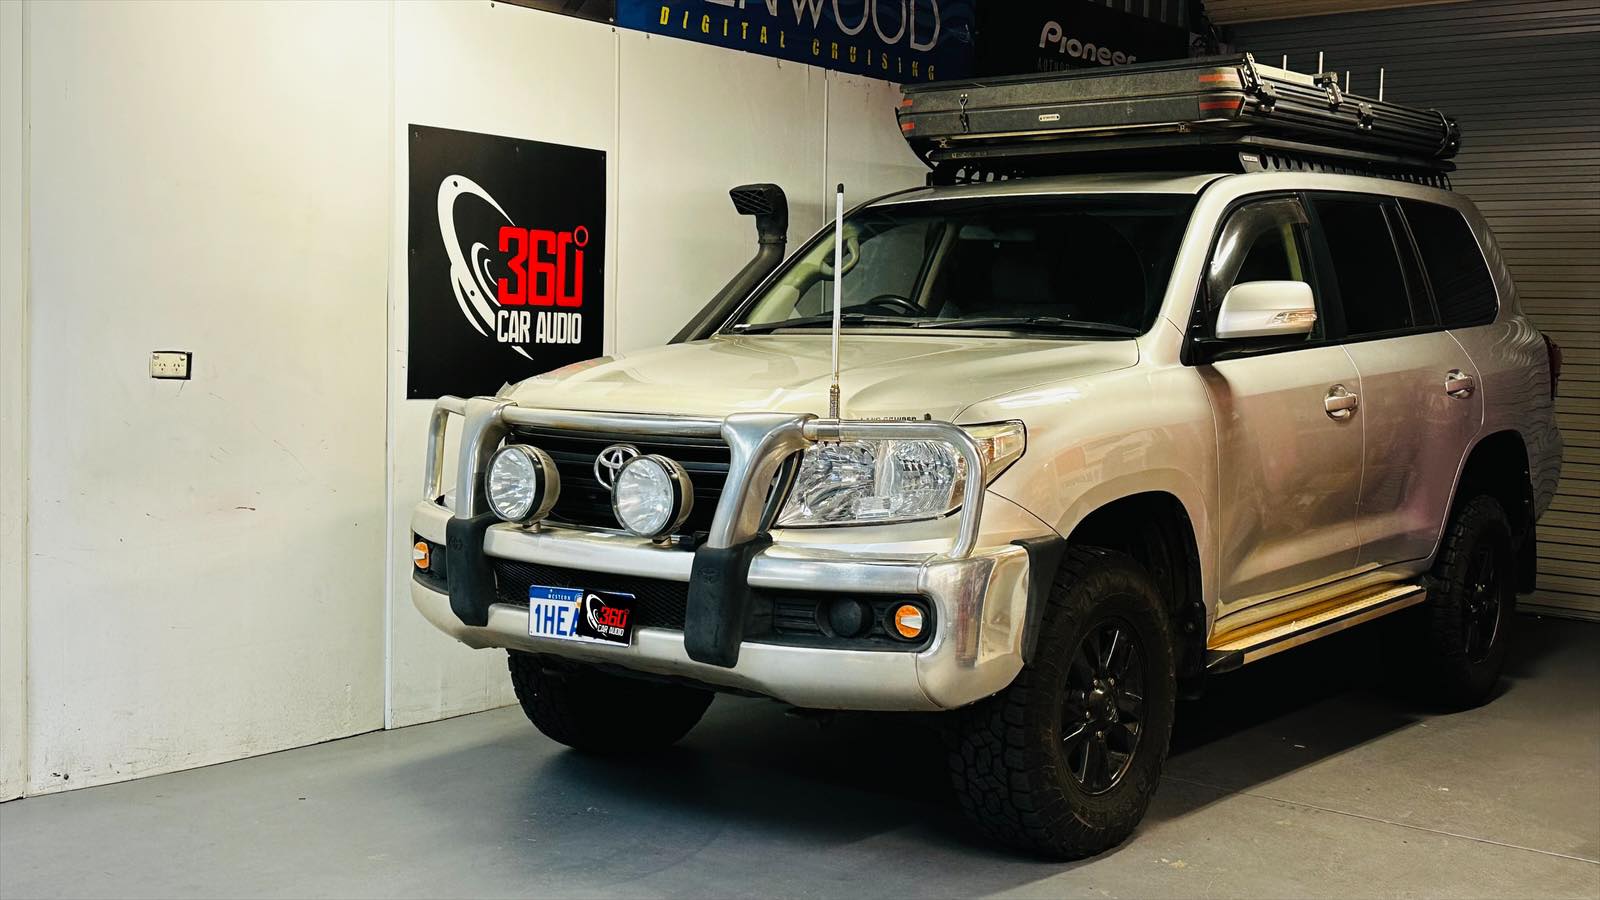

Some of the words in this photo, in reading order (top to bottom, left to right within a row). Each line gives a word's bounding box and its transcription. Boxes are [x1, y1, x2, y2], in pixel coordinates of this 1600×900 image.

[660, 6, 785, 48] DIGITAL
[812, 38, 935, 80] CRUISING
[1040, 20, 1136, 66] Pioneer
[497, 310, 531, 344] CAR
[535, 311, 582, 344] AUDIO
[535, 603, 580, 636] 1HEA
[597, 624, 608, 634] CAR
[609, 626, 625, 637] AUDIO
